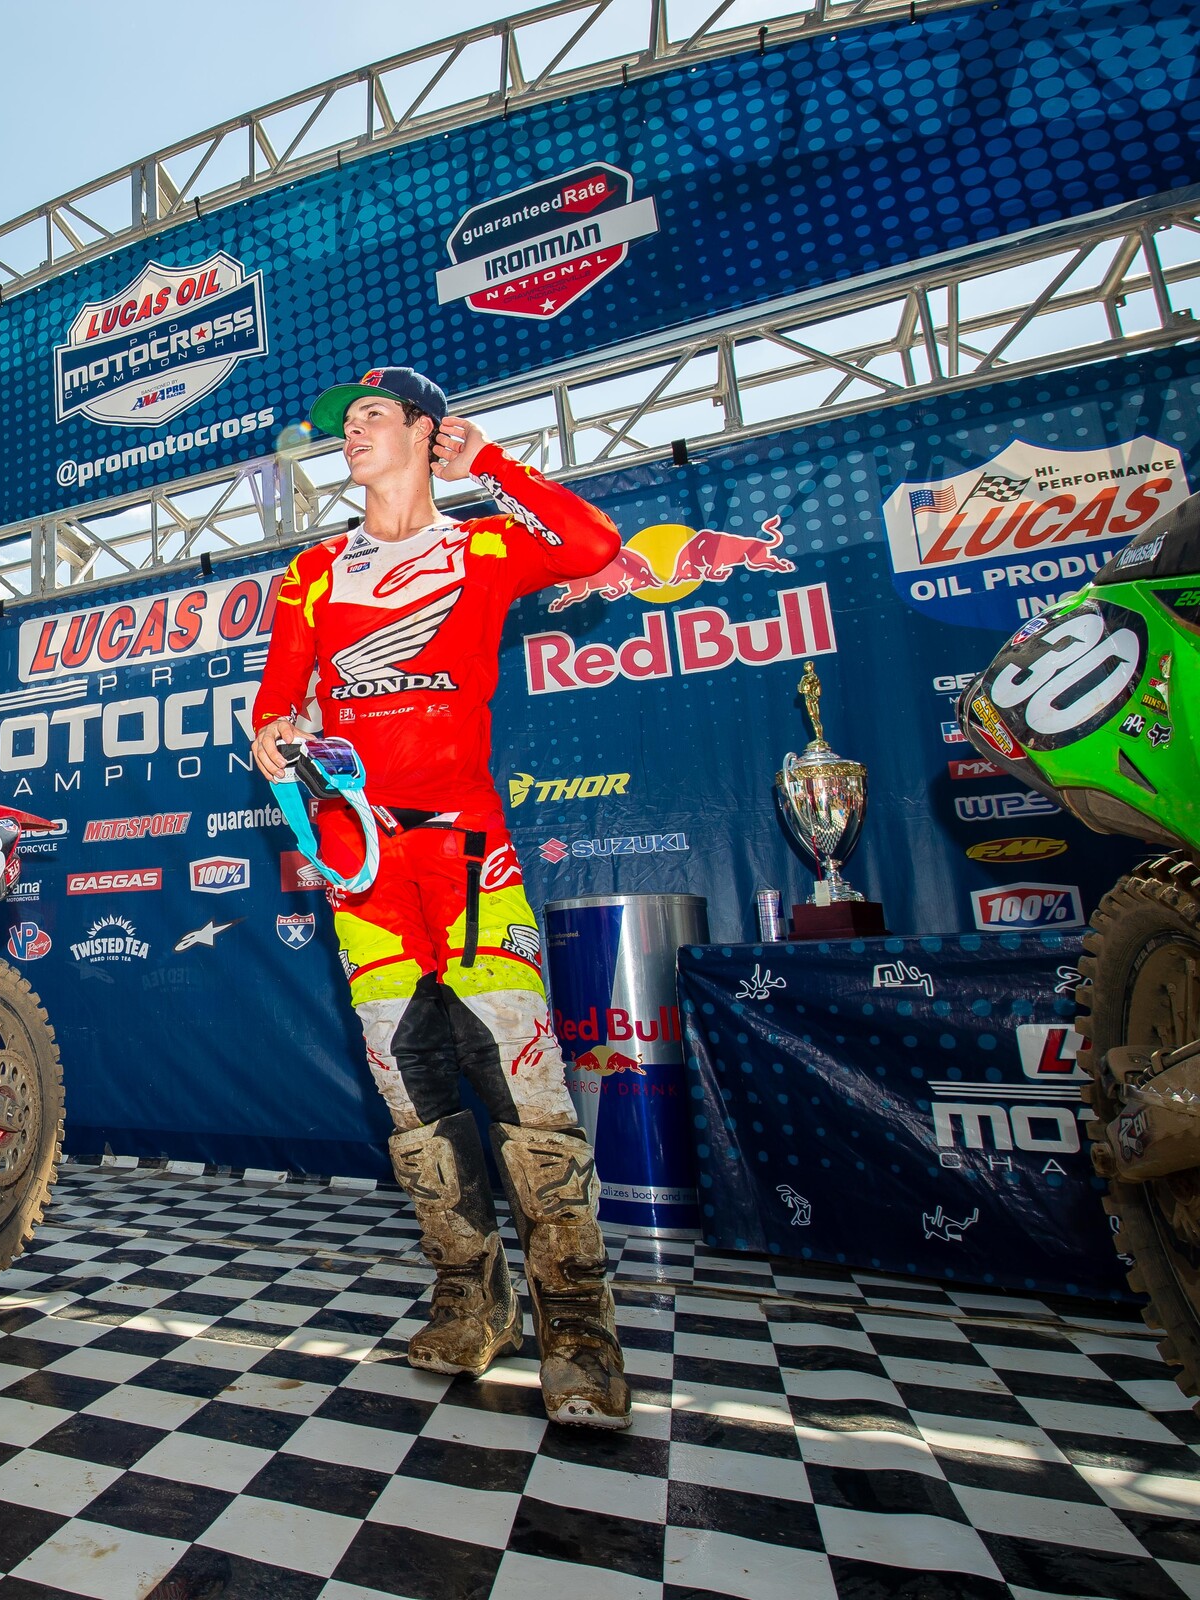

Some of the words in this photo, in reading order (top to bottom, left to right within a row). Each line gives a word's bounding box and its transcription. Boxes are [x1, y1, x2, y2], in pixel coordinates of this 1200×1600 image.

[484, 223, 602, 281] IRONMAN
[486, 256, 607, 301] NATIONAL
[86, 287, 171, 341] LUCAS
[176, 268, 220, 306] OIL
[130, 324, 178, 347] PRO
[64, 305, 254, 391] MOTOCROSS
[65, 328, 255, 400] CHAMPIONSHIP
[130, 389, 166, 411] AMA
[166, 383, 186, 395] PRO
[56, 407, 275, 488] @promotocross
[1035, 465, 1060, 477] HI-
[1038, 459, 1176, 491] PERFORMANCE
[921, 478, 1172, 565] LUCAS
[342, 547, 379, 561] SHOWA
[1116, 531, 1167, 568] Kawasaki
[349, 563, 370, 573] 100%
[910, 576, 971, 600] OIL
[29, 590, 207, 676] LUCAS
[524, 611, 672, 694] Red
[674, 583, 837, 674] Bull
[100, 656, 230, 695] PRO
[332, 671, 458, 699] HONDA
[991, 614, 1141, 735] 30
[368, 707, 414, 718] DUNLOP
[1122, 713, 1144, 733] PPG
[972, 699, 1012, 752] CIRCUIT
[957, 762, 997, 776] MX
[534, 773, 630, 802] THOR
[572, 833, 686, 857] SUZUKI
[967, 839, 1066, 859] FMF
[69, 872, 158, 891] GASGAS
[198, 865, 241, 885] 100%
[987, 892, 1067, 922] 100%
[9, 922, 38, 960] VP
[286, 925, 307, 942] X
[27, 939, 50, 955] Racing
[70, 937, 125, 961] TWISTED
[125, 937, 151, 959] TEA
[606, 1007, 681, 1042] Bull
[617, 1081, 678, 1097] DRINK
[939, 1153, 1067, 1176] CHA
[632, 1188, 658, 1202] body
[662, 1192, 680, 1201] and
